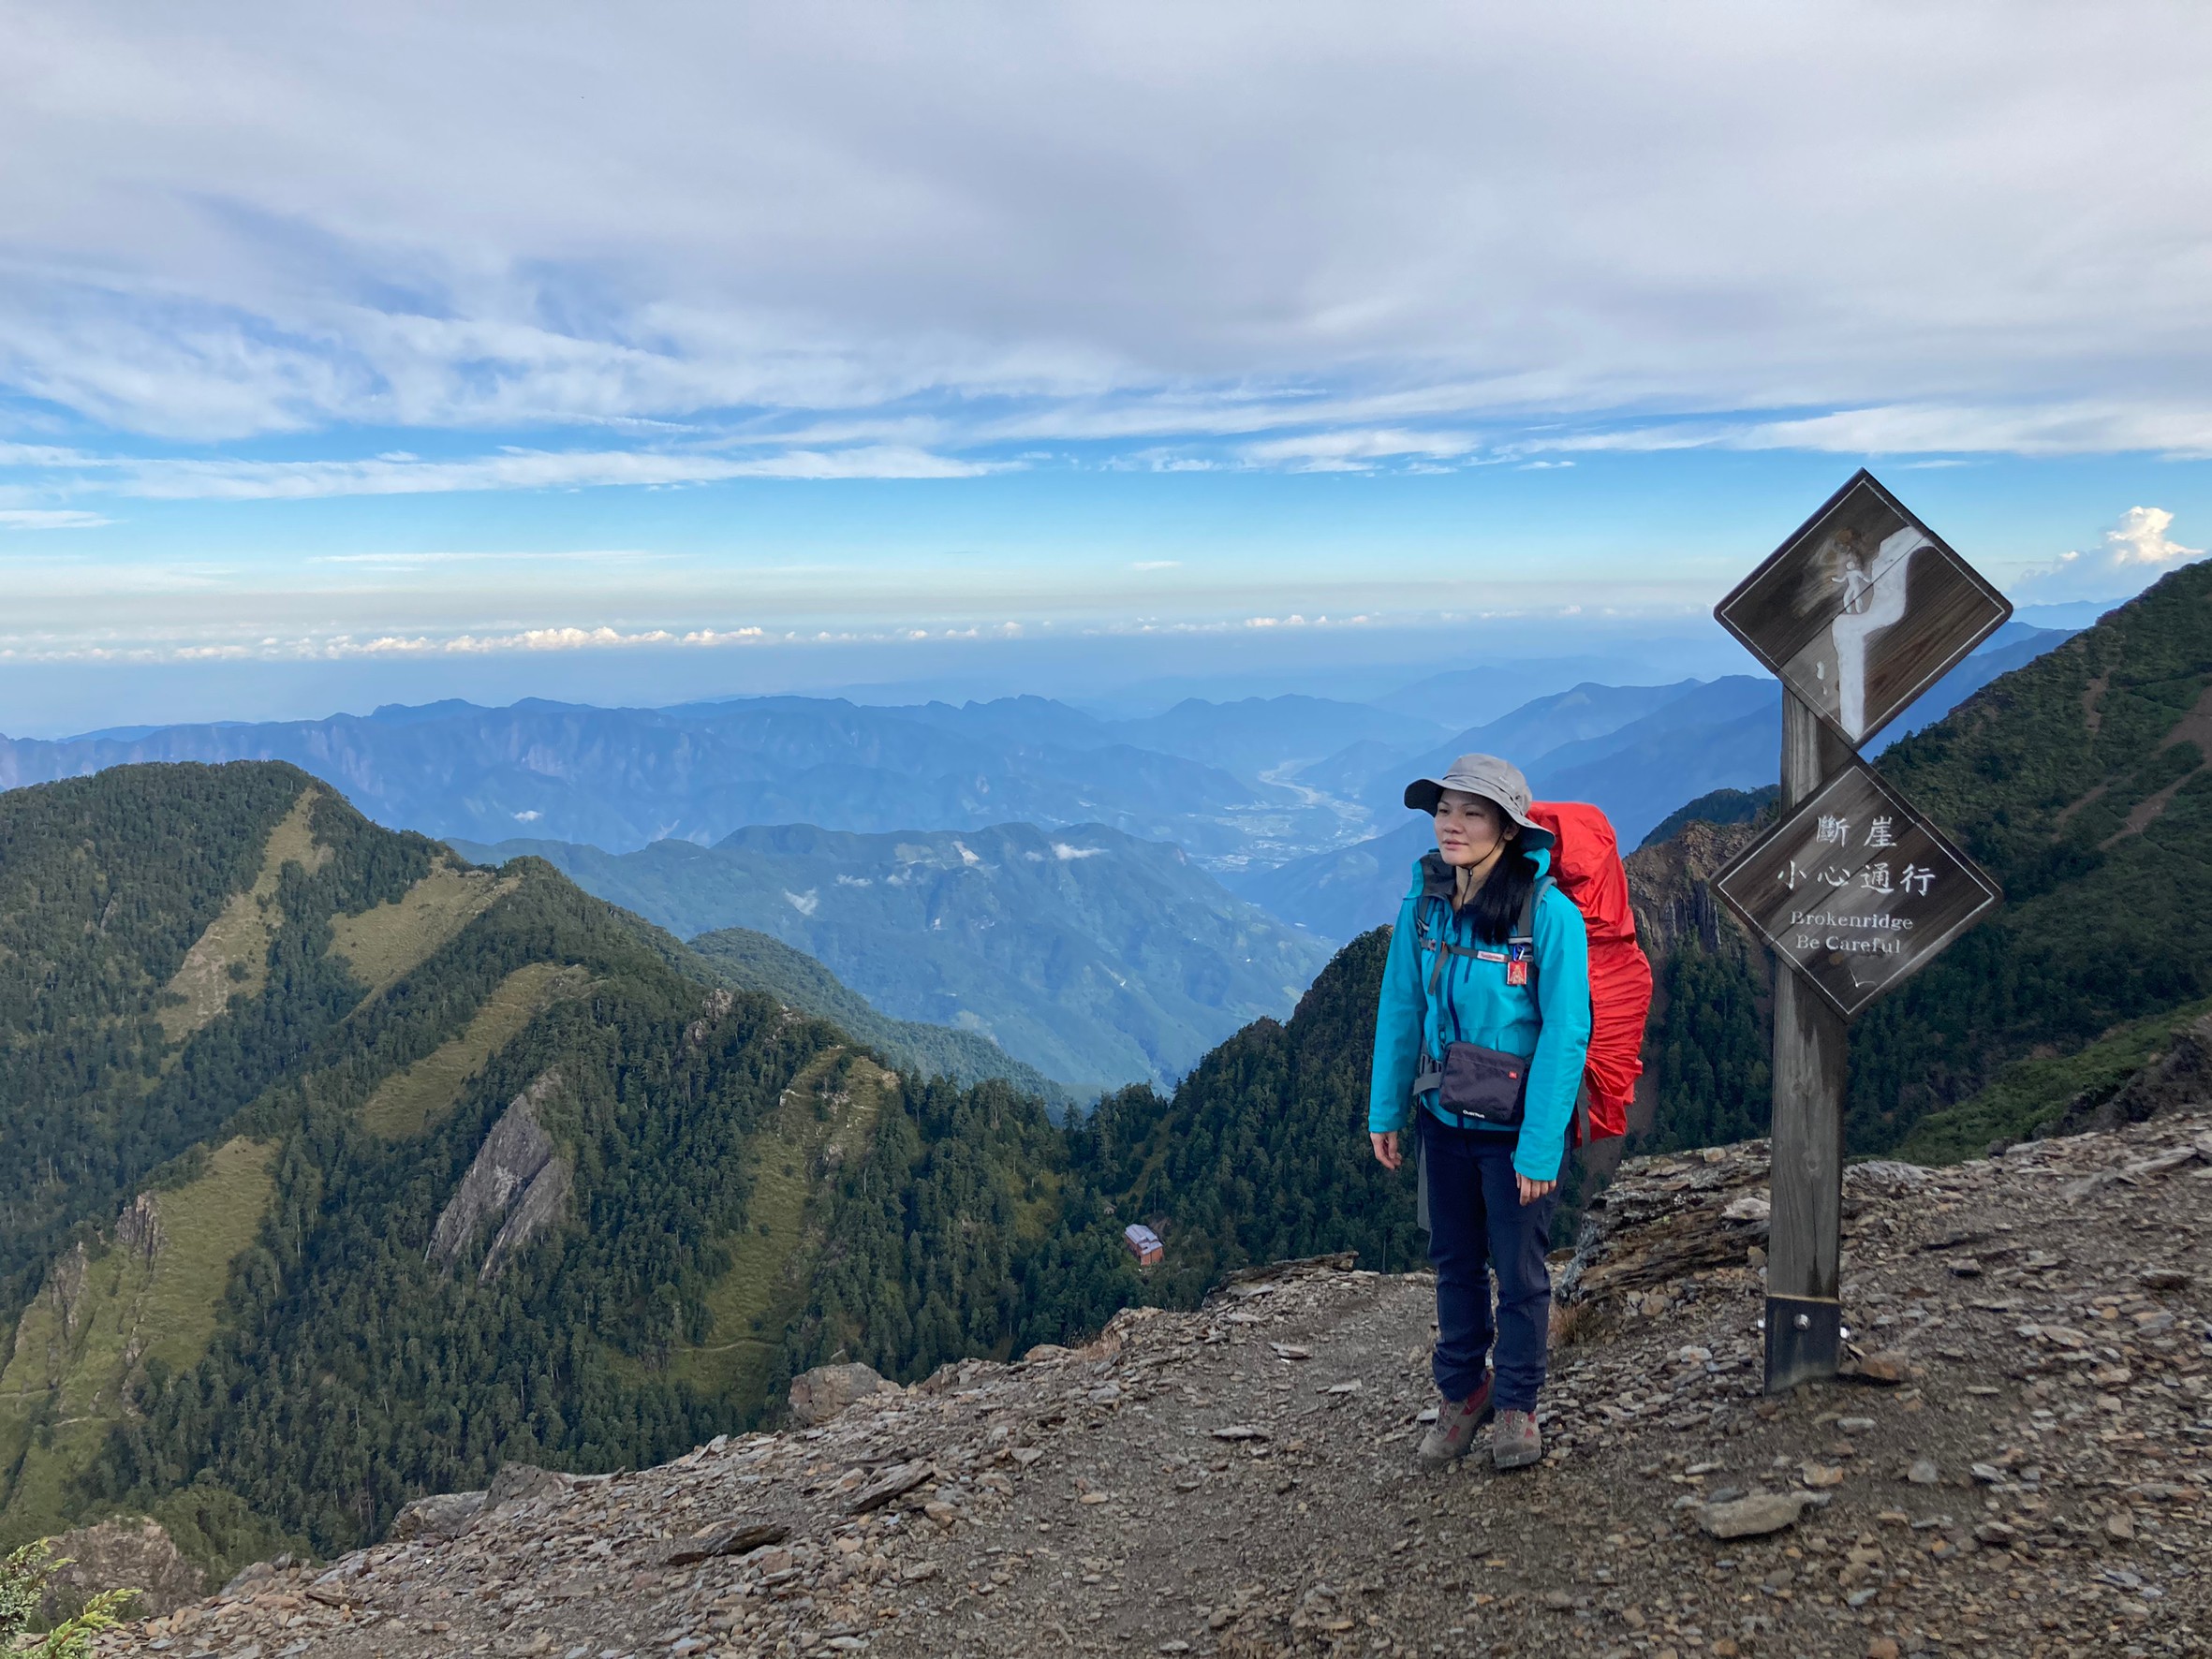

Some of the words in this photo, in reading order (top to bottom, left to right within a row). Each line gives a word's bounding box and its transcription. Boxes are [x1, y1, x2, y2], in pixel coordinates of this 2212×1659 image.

[1816, 815, 1897, 847] 斷崖
[1777, 859, 1936, 897] 小心通行
[1790, 910, 1913, 931] Brokenridge
[1795, 934, 1821, 949] Be
[1825, 935, 1901, 954] Careful
